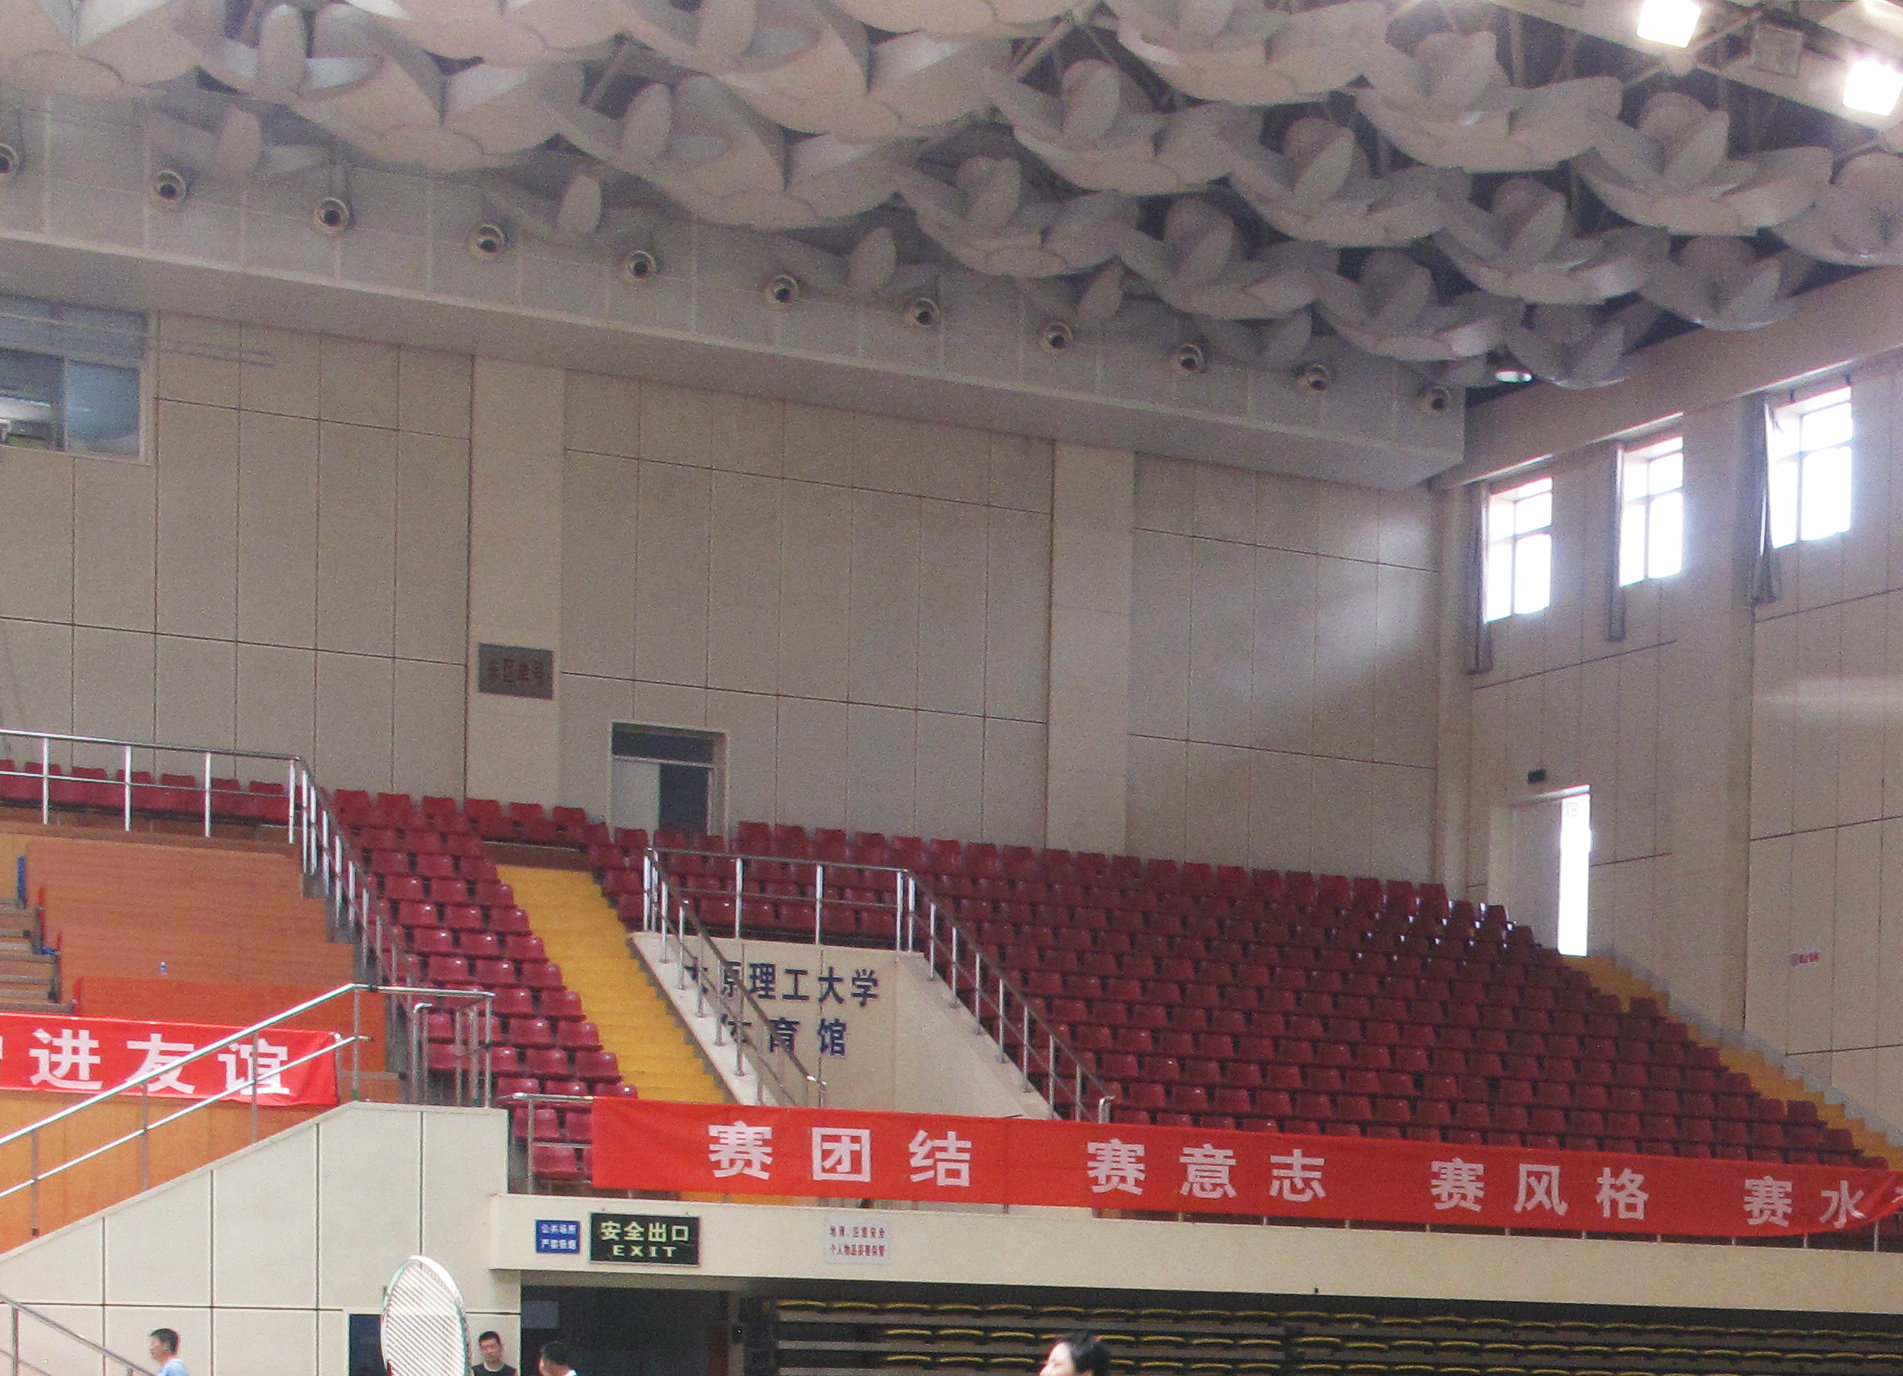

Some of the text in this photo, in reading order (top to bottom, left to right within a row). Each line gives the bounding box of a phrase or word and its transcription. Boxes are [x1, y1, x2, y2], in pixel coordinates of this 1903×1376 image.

[0, 1028, 292, 1096] 进友谊
[708, 1120, 973, 1187] 赛团结
[1087, 1137, 1326, 1203] 赛意志
[1430, 1157, 1650, 1221] 赛风格
[601, 1221, 690, 1243] 安全出口
[612, 1244, 677, 1258] EXIT
